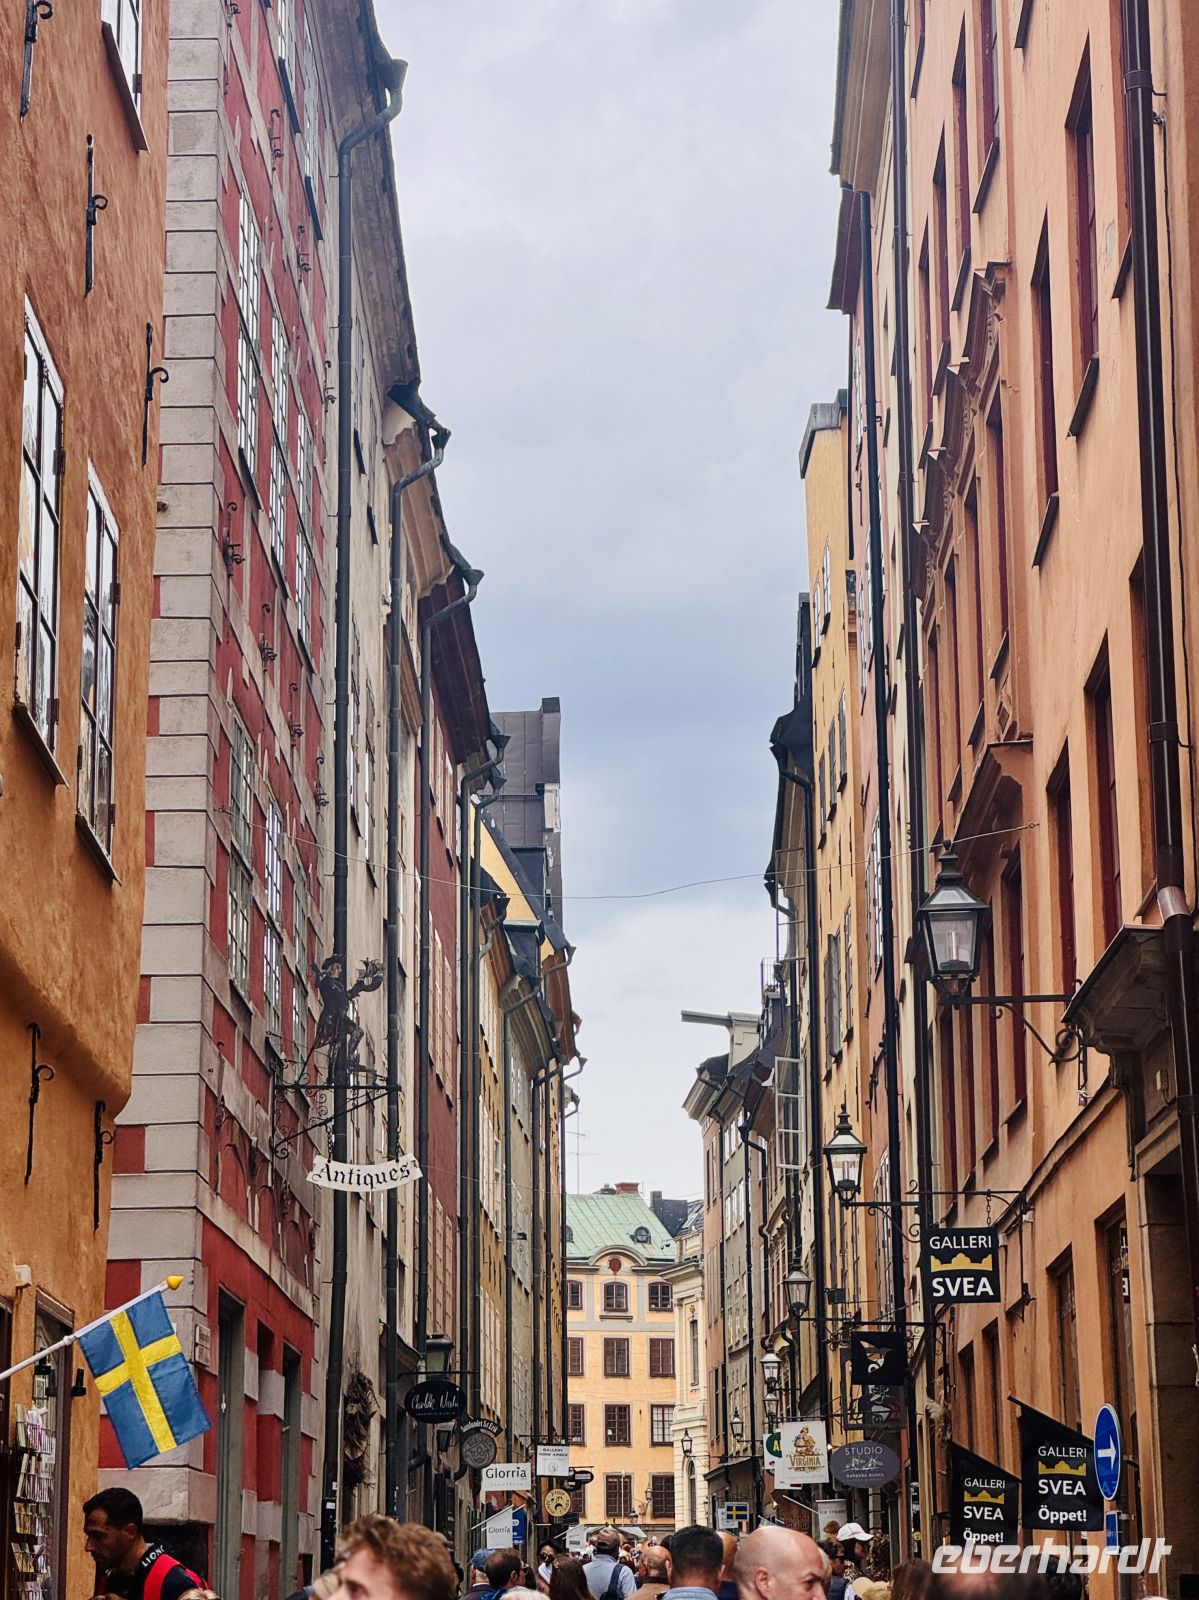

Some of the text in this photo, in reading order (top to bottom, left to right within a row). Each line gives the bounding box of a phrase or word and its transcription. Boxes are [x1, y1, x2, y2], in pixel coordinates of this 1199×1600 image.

[312, 1161, 411, 1190] Antiques
[929, 1235, 992, 1250] GALLERI
[932, 1277, 995, 1297] SVEA
[844, 1446, 883, 1456] STUDIO
[1038, 1446, 1087, 1458] GALLERI
[789, 1453, 821, 1467] VIRGINIA
[485, 1466, 527, 1479] Glorria
[964, 1477, 1006, 1489] GALLERI
[1038, 1479, 1087, 1496] SVEA
[963, 1505, 1004, 1521] SVEA
[1038, 1504, 1087, 1524] Öppet!
[963, 1527, 1004, 1545] Öppet!
